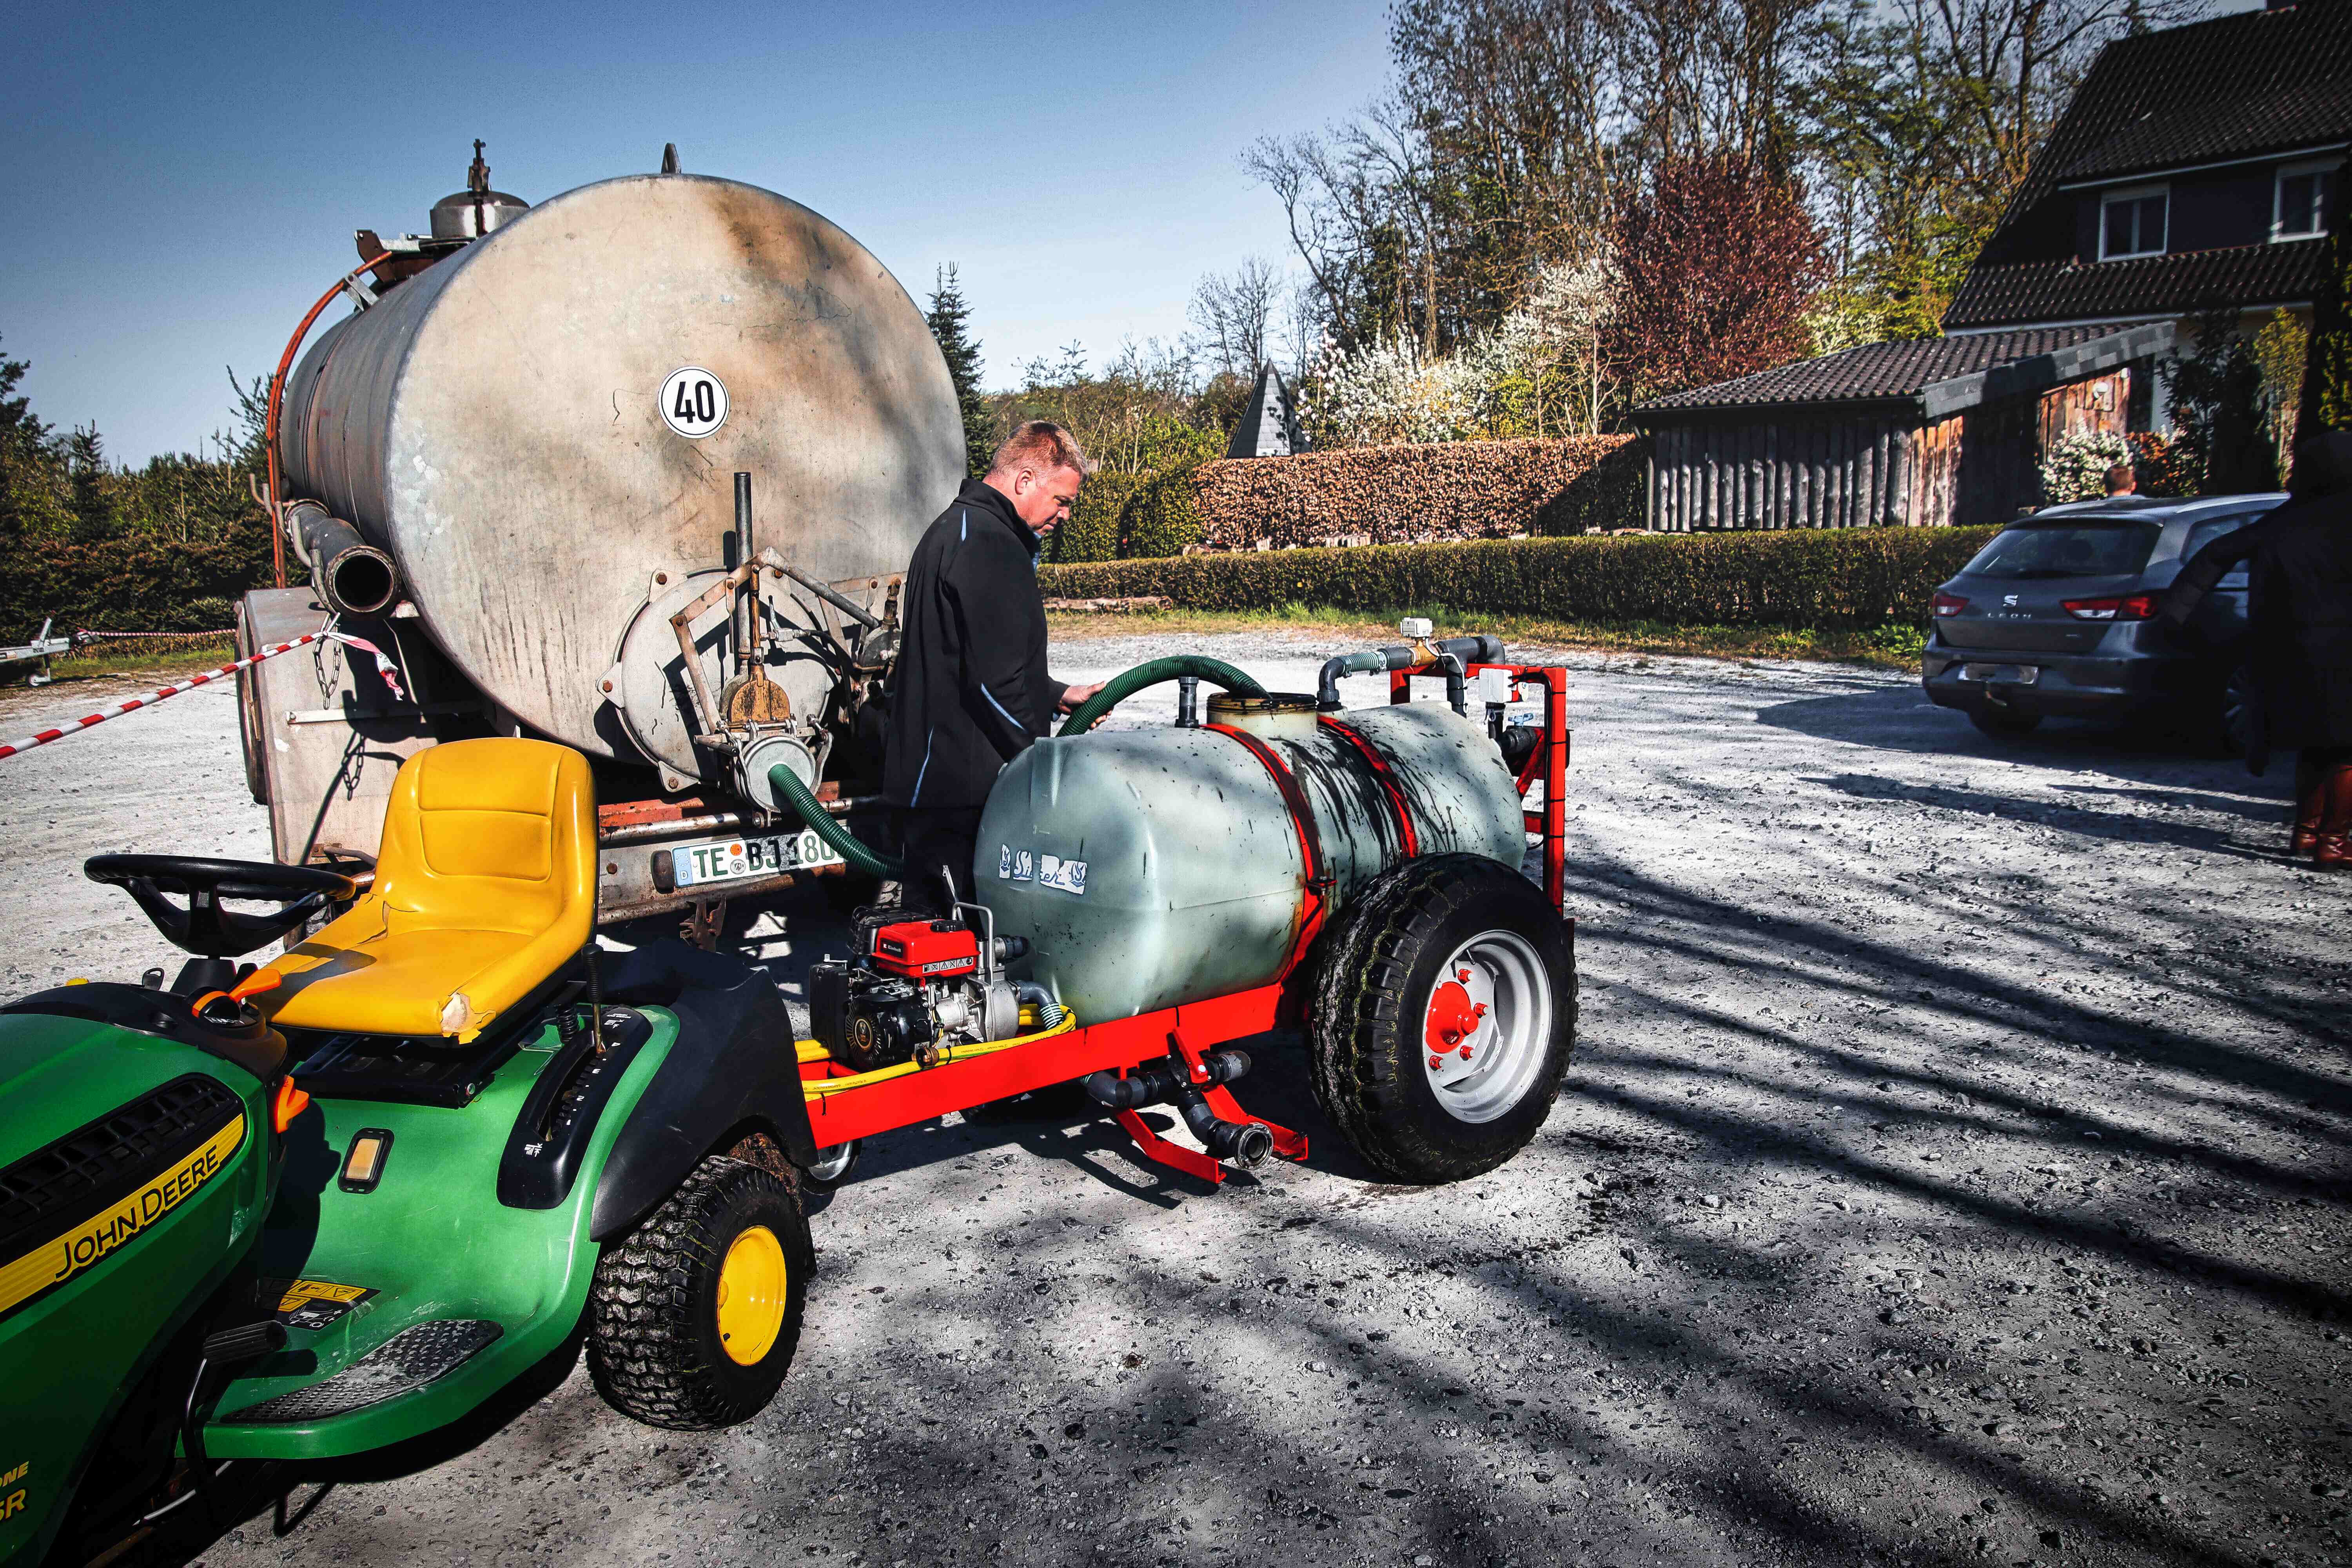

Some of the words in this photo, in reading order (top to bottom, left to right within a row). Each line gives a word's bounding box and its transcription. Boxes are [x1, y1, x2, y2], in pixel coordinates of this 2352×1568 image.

[674, 380, 715, 423] 40
[681, 870, 688, 880] D
[693, 847, 728, 878] TE
[746, 840, 780, 871] BJ
[786, 835, 843, 865] 180
[55, 1207, 137, 1280] JOHN
[141, 1144, 220, 1218] DEERE
